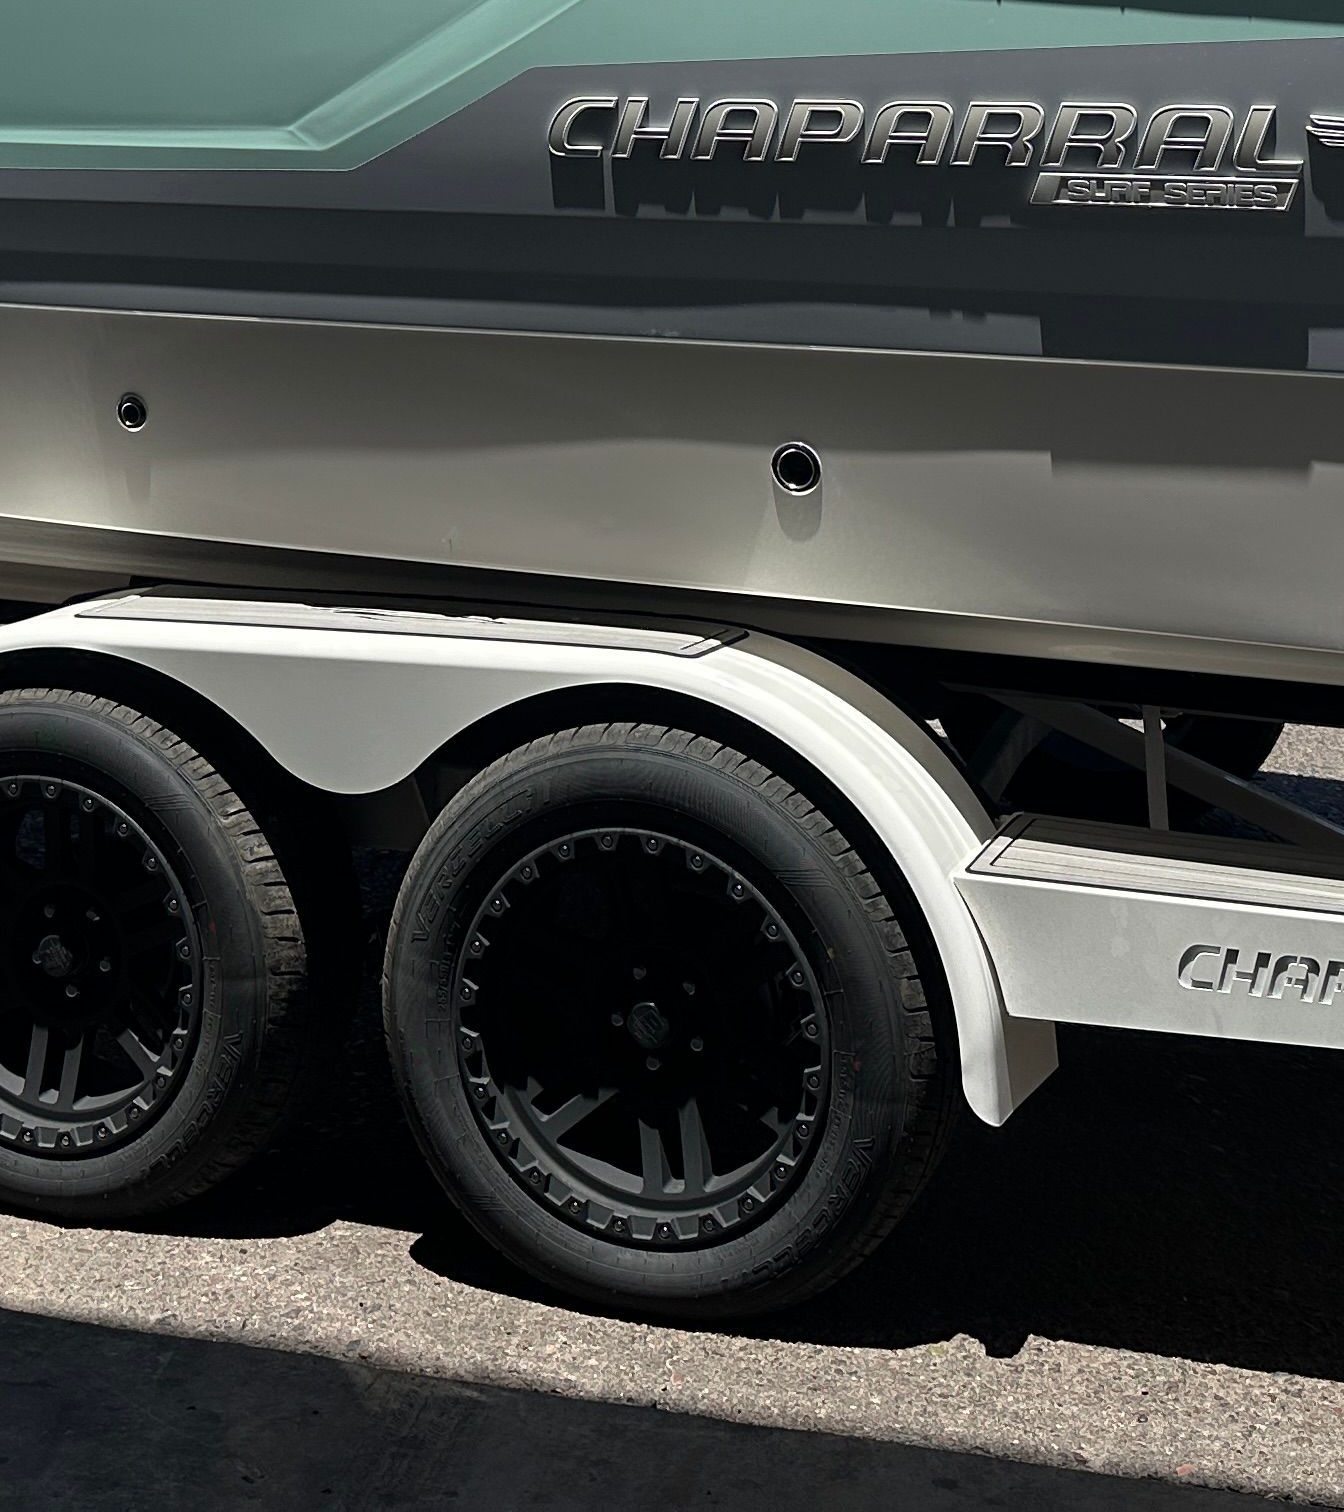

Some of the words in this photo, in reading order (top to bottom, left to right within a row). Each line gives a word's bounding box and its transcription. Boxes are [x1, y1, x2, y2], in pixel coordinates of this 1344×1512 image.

[547, 95, 1304, 174] CHAPARRAL
[1067, 179, 1151, 204] SURF
[1164, 182, 1278, 208] SERIES
